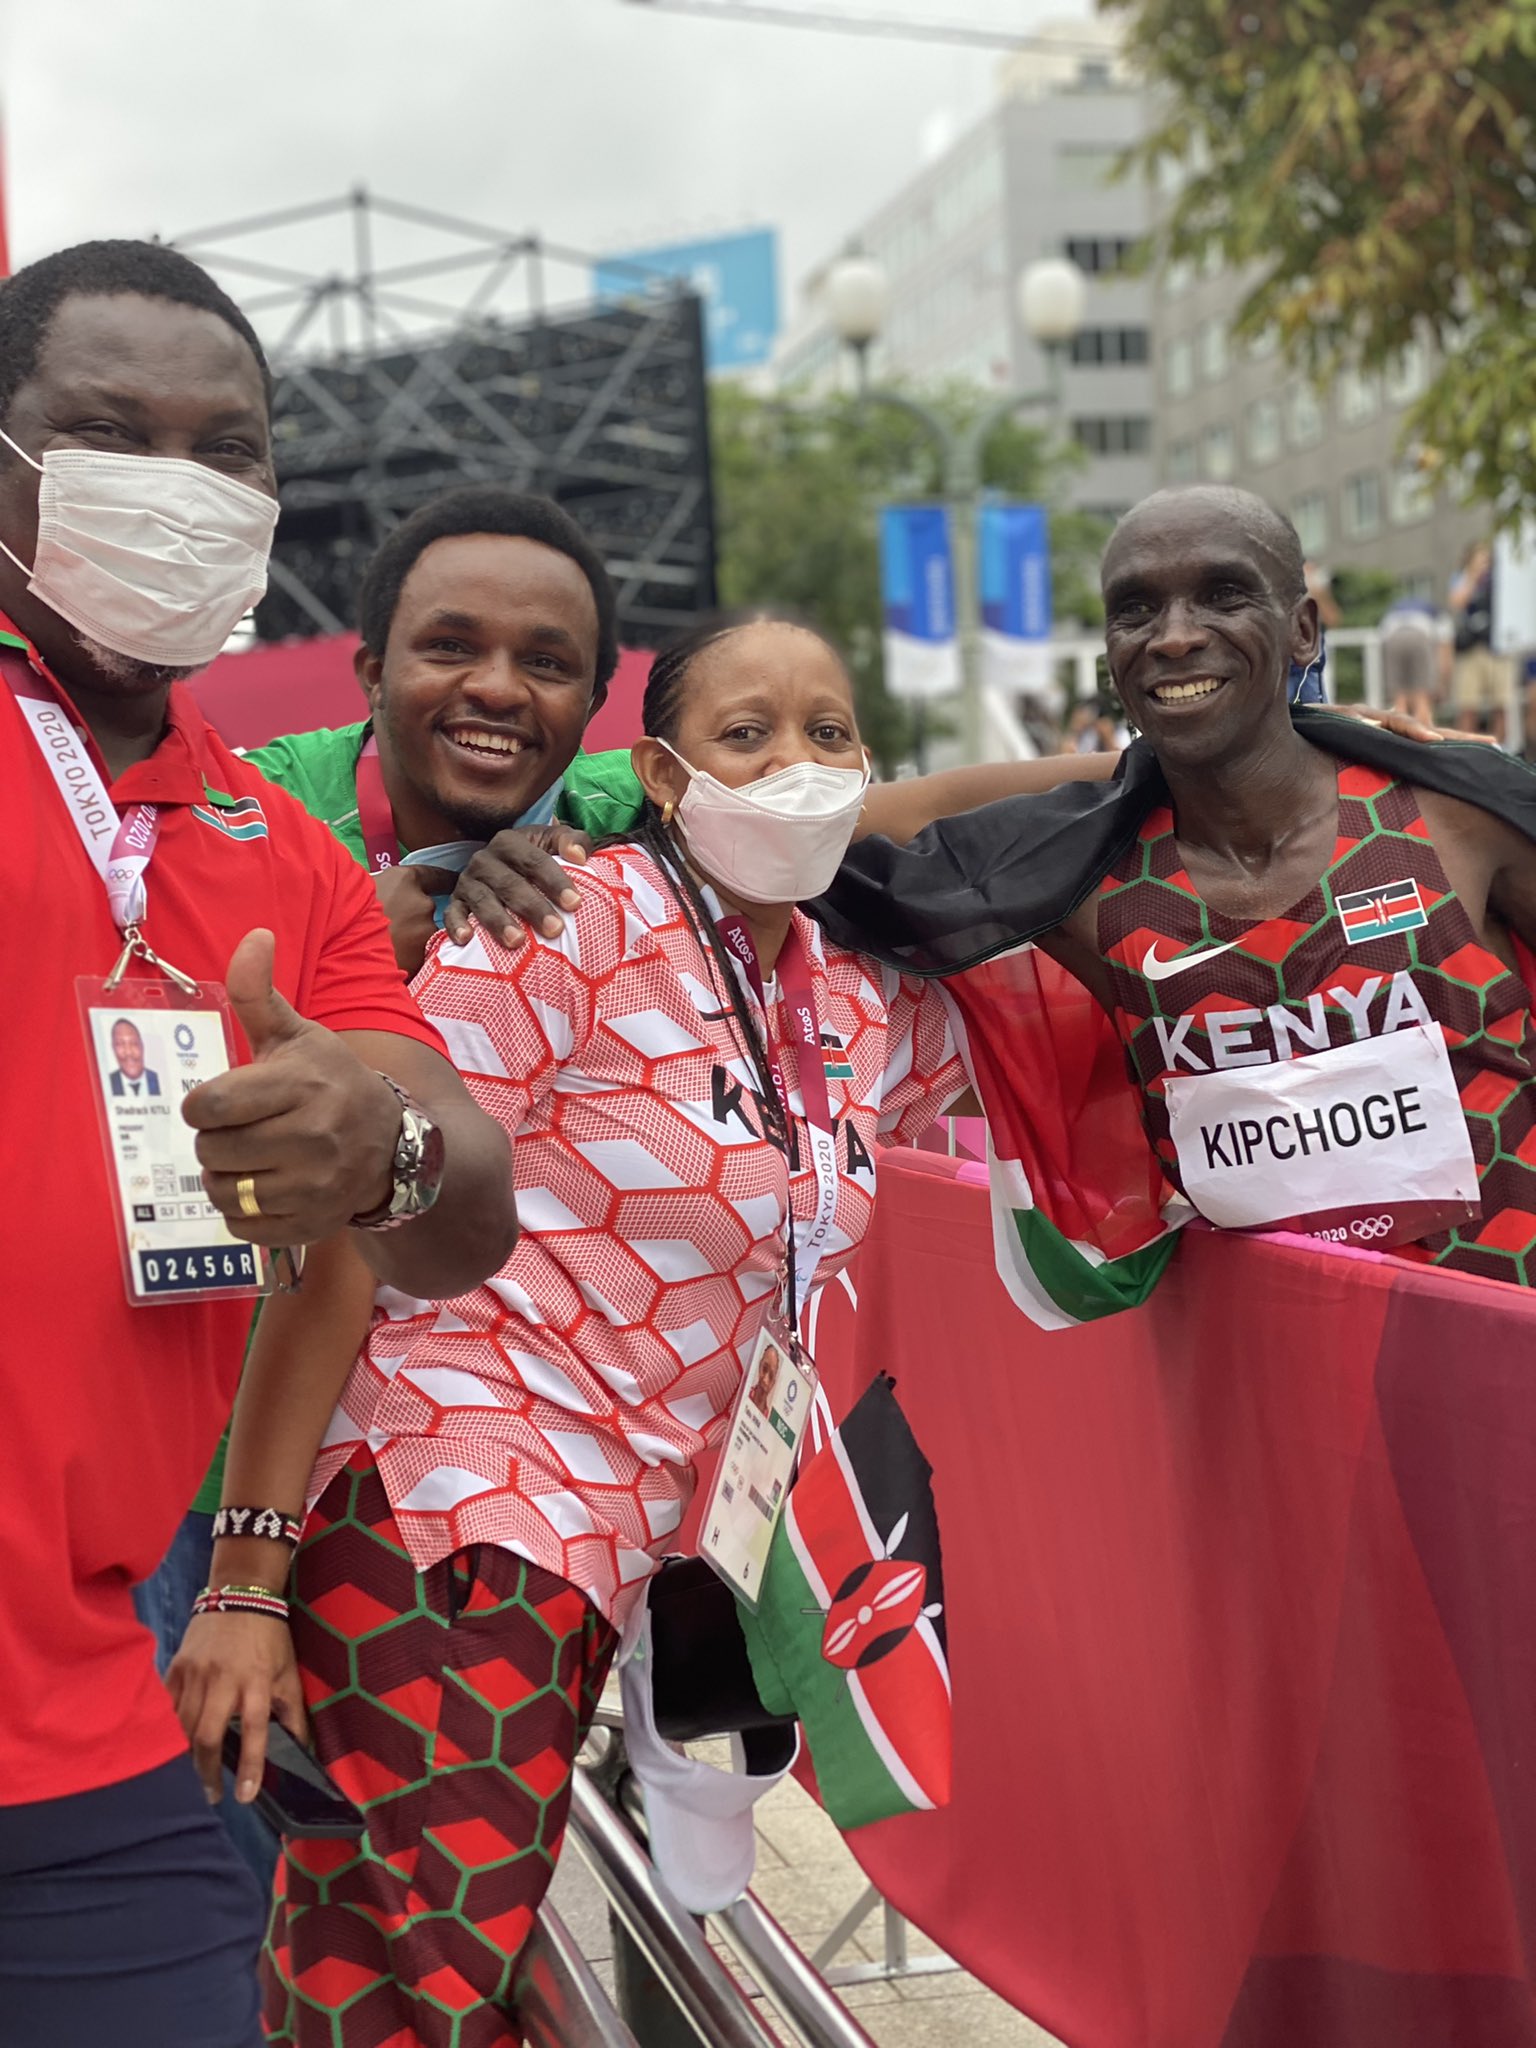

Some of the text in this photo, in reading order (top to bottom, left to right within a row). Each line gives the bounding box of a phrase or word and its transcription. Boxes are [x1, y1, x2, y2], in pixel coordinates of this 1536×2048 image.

[36, 710, 112, 841] TOKYO 2020
[125, 812, 153, 849] 2020
[1152, 969, 1434, 1072] KENYA
[1199, 1085, 1428, 1169] KIPCHOGE
[807, 1139, 835, 1249] TOKYO 2020
